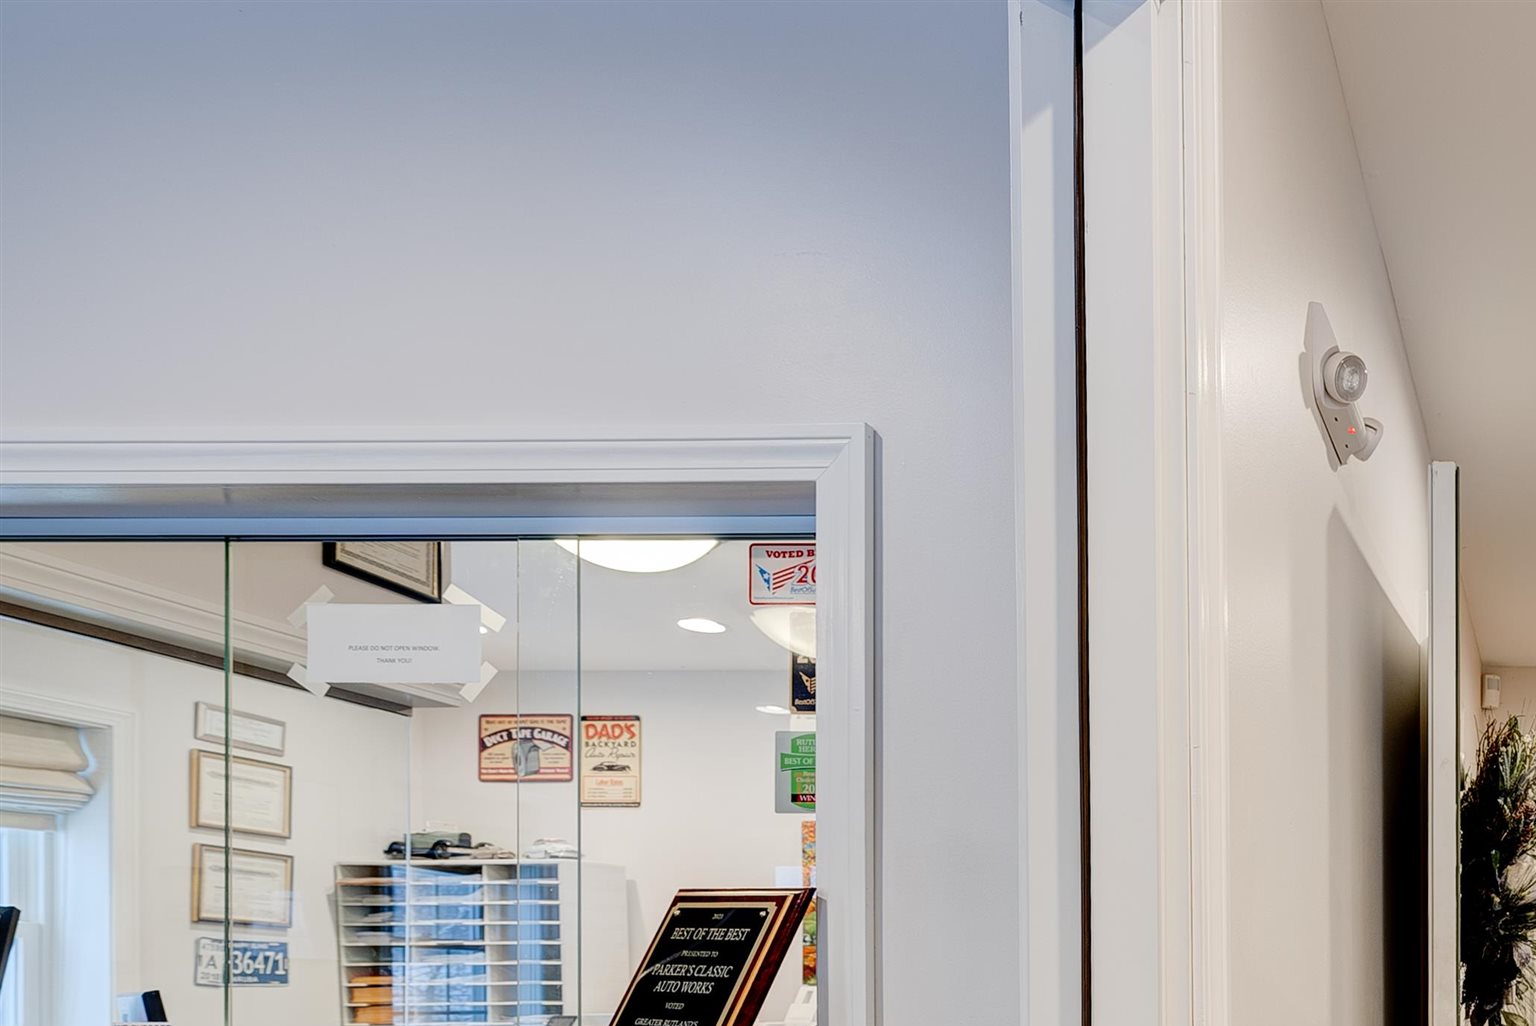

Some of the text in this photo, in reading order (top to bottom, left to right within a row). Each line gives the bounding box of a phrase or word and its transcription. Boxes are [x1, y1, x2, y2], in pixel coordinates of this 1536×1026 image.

[765, 549, 804, 559] VOTED
[584, 722, 637, 741] DAD'S
[584, 740, 637, 748] BACKYARD
[784, 757, 814, 765] BEST OF
[670, 927, 751, 941] BEST OF THE BEST
[680, 950, 719, 958] PRESENTED TO
[651, 963, 734, 978] PARKER'S CLASSIC
[653, 980, 715, 994] AUTO WORKS
[664, 1002, 685, 1010] VOTED
[634, 1017, 662, 1026] GREATER
